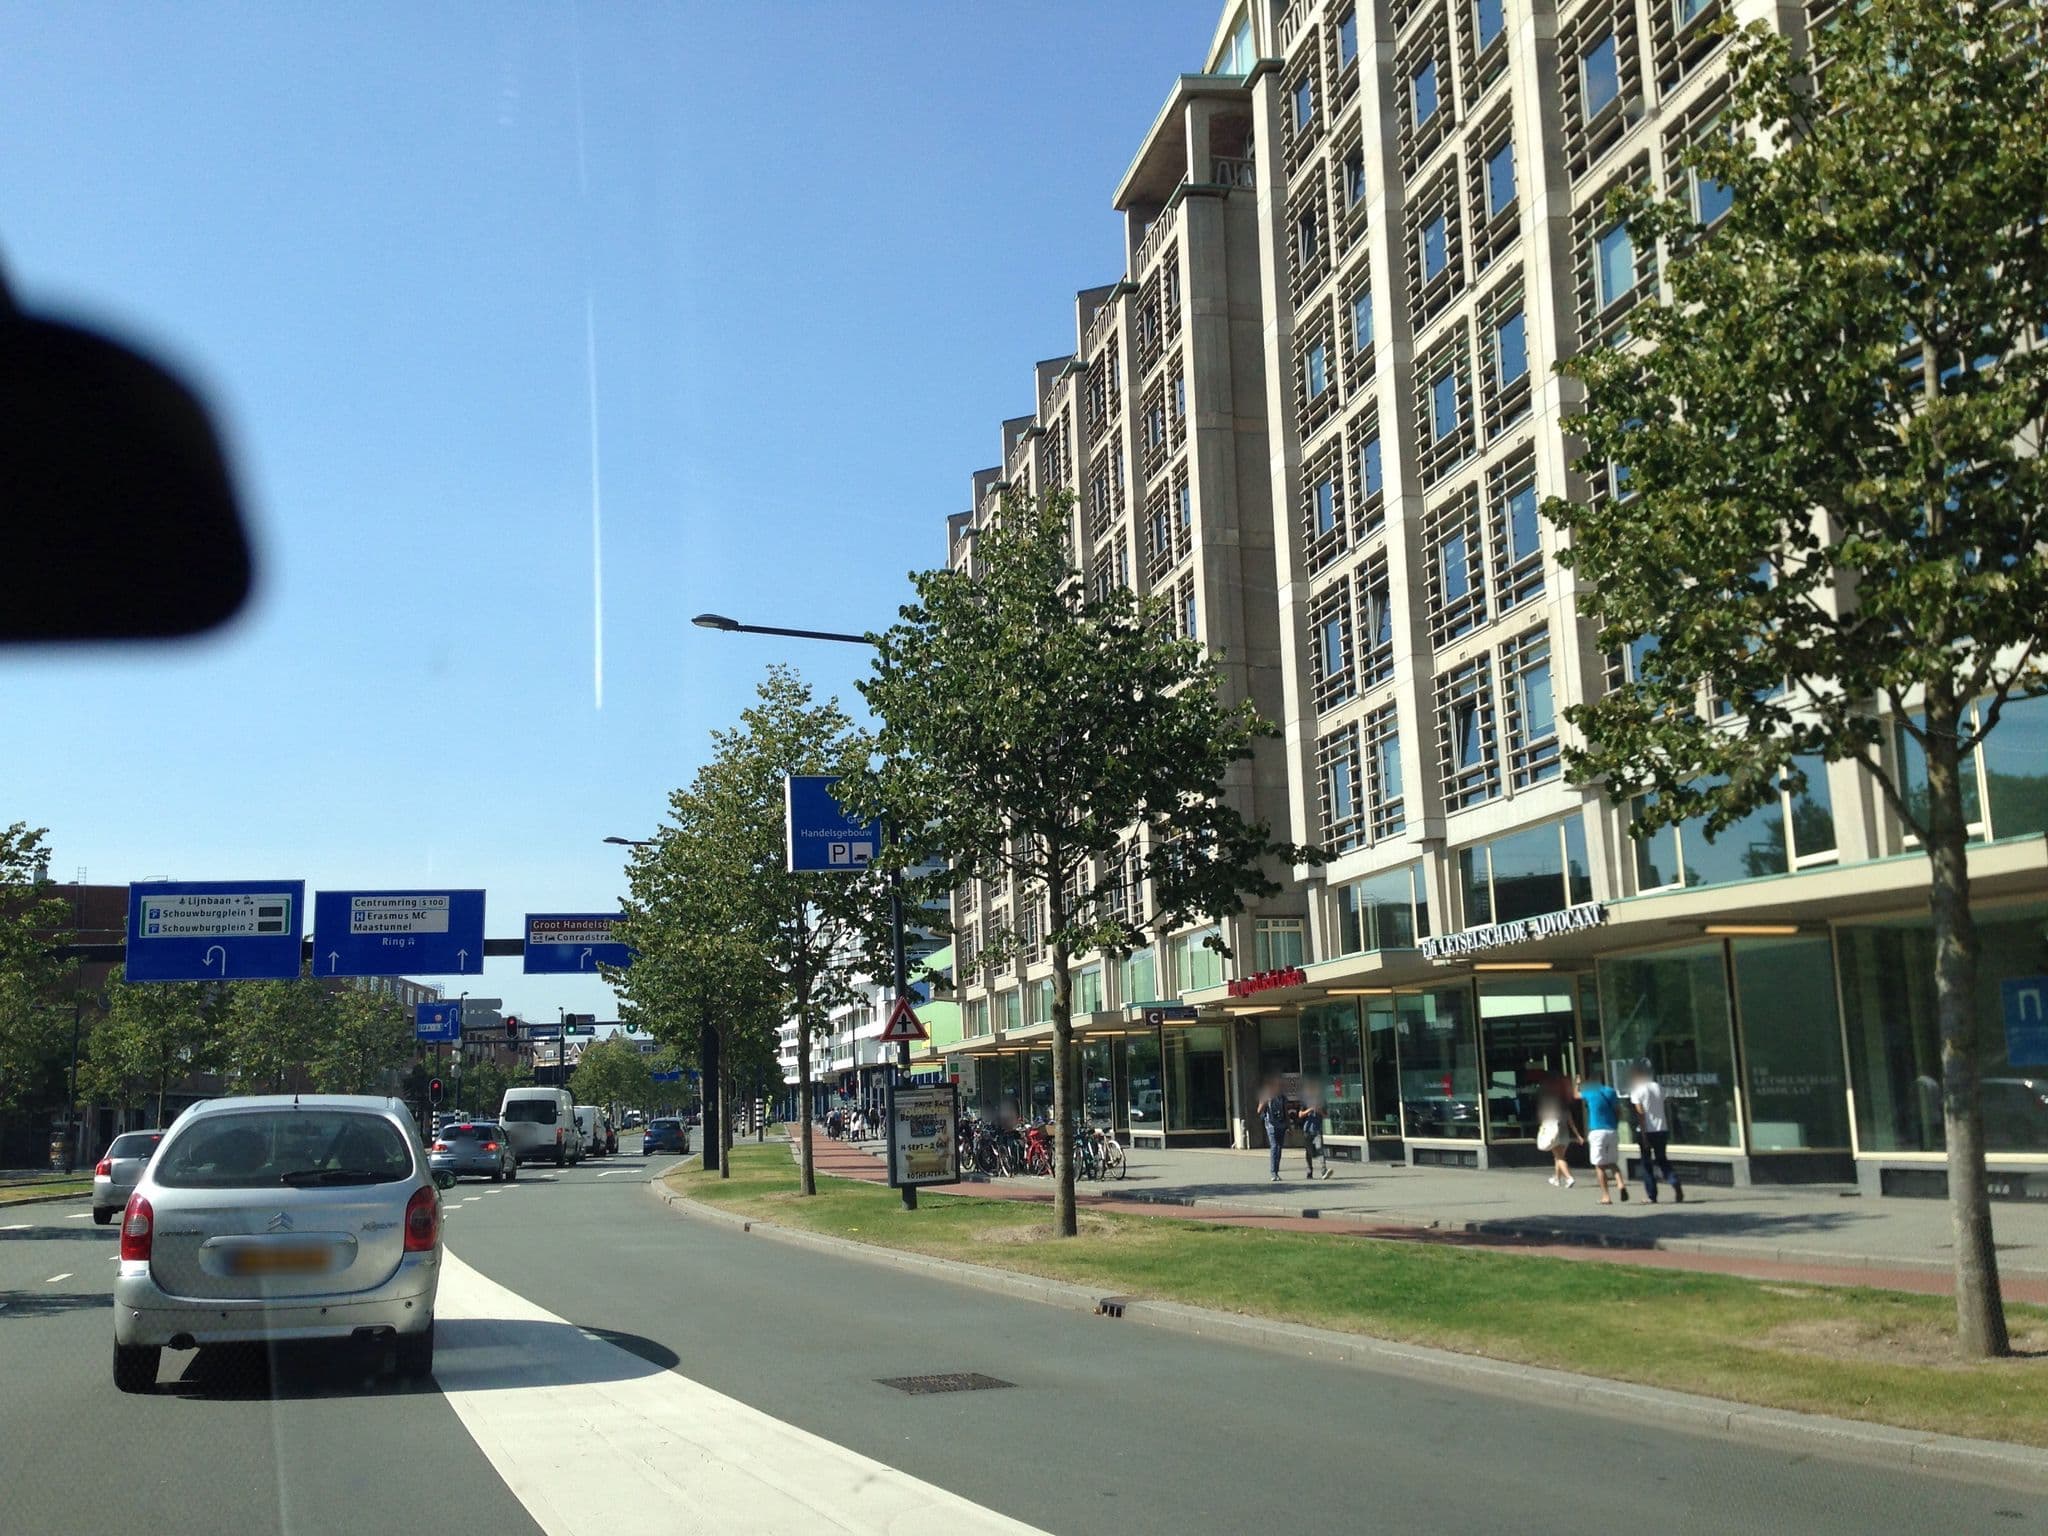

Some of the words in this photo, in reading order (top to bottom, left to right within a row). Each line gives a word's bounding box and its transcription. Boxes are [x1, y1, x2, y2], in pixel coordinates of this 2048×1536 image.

[801, 828, 872, 839] Handelsgebouw
[833, 845, 846, 862] P
[188, 897, 231, 906] Lijnbaan
[354, 898, 416, 908] Centrumring
[163, 908, 246, 920] Schouwburgplein
[368, 912, 409, 920] Erasmus
[412, 911, 427, 919] MC
[162, 924, 246, 934] Schouwburgplein
[248, 923, 254, 931] 2
[354, 923, 412, 931] Maastunnel
[533, 920, 560, 929] Groot
[564, 920, 611, 930] Handelsg
[1439, 921, 1528, 954] LETSELSCHADE
[1533, 904, 1602, 936] ADVOCAAT
[382, 938, 405, 947] Ring
[1149, 1012, 1159, 1024] C
